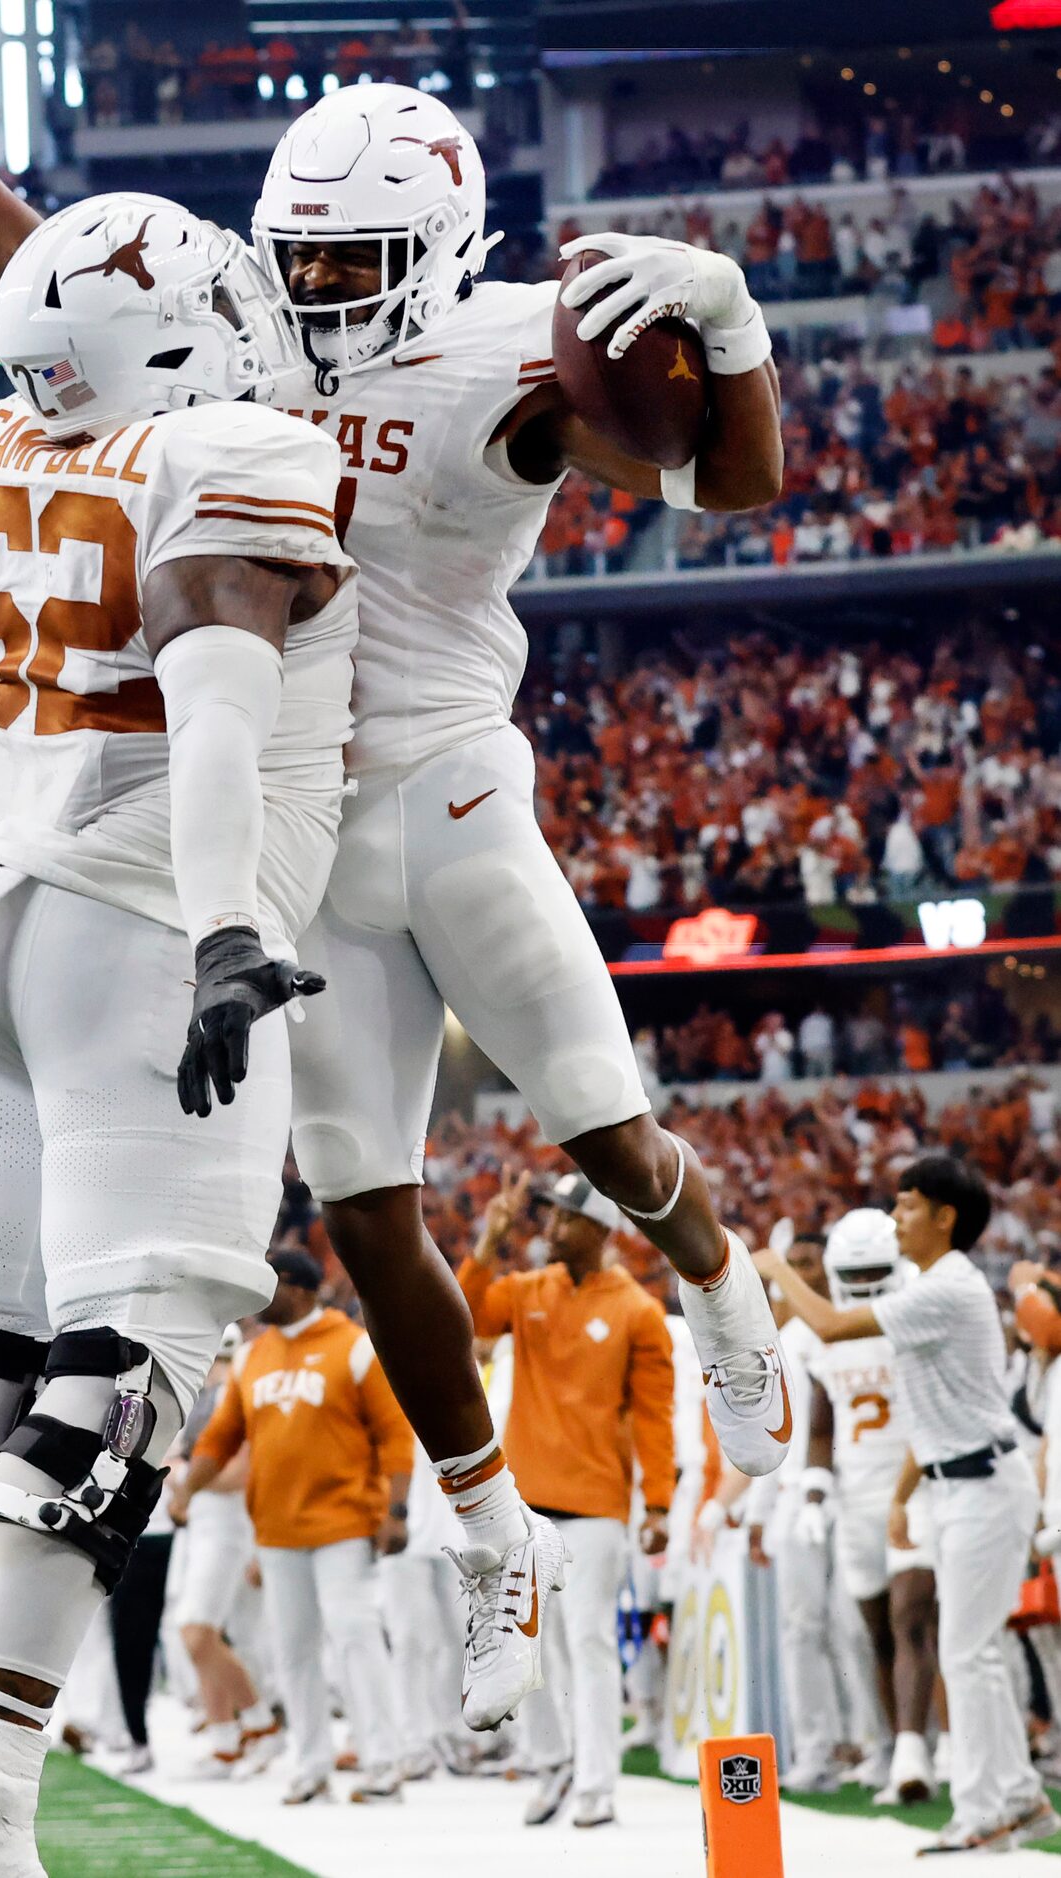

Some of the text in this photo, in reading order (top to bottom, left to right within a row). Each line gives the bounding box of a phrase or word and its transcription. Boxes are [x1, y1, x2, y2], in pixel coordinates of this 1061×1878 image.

[291, 203, 329, 216] HORNS
[917, 898, 987, 950] VS
[252, 1369, 326, 1409] TEXAS
